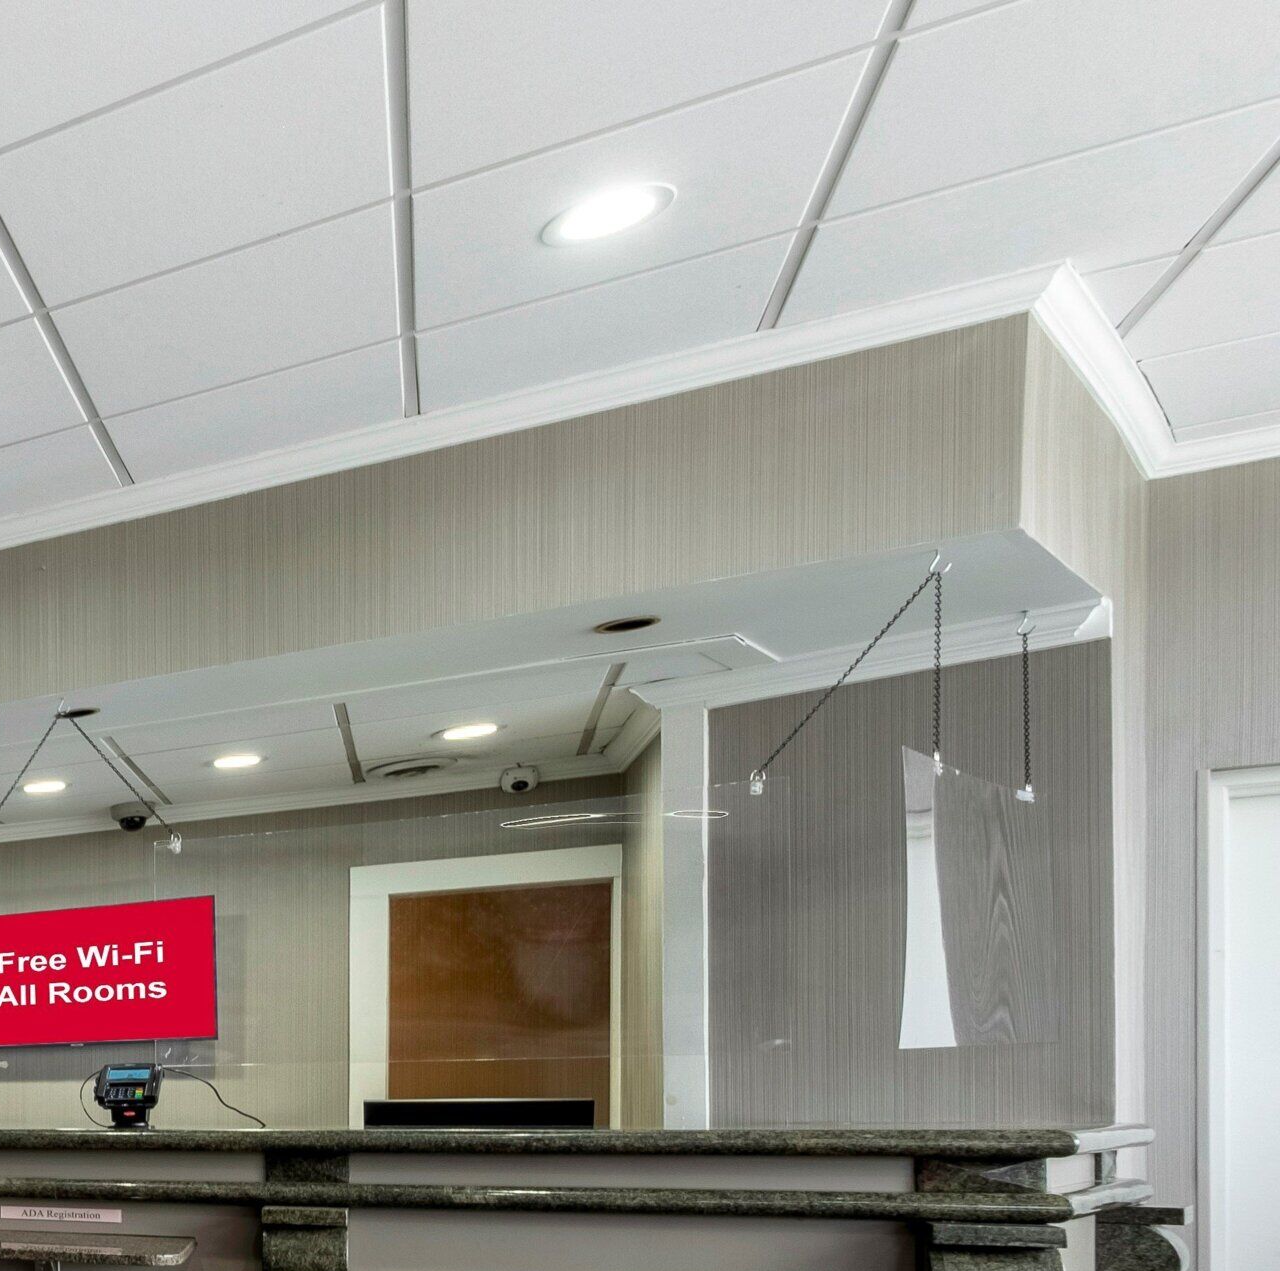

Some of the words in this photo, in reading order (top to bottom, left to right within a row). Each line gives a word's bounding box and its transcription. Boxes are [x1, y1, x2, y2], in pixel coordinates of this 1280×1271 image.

[76, 941, 164, 969] Wi-Fi
[48, 981, 168, 1005] Rooms
[21, 1208, 44, 1217] ADA
[46, 1209, 101, 1219] Registration
